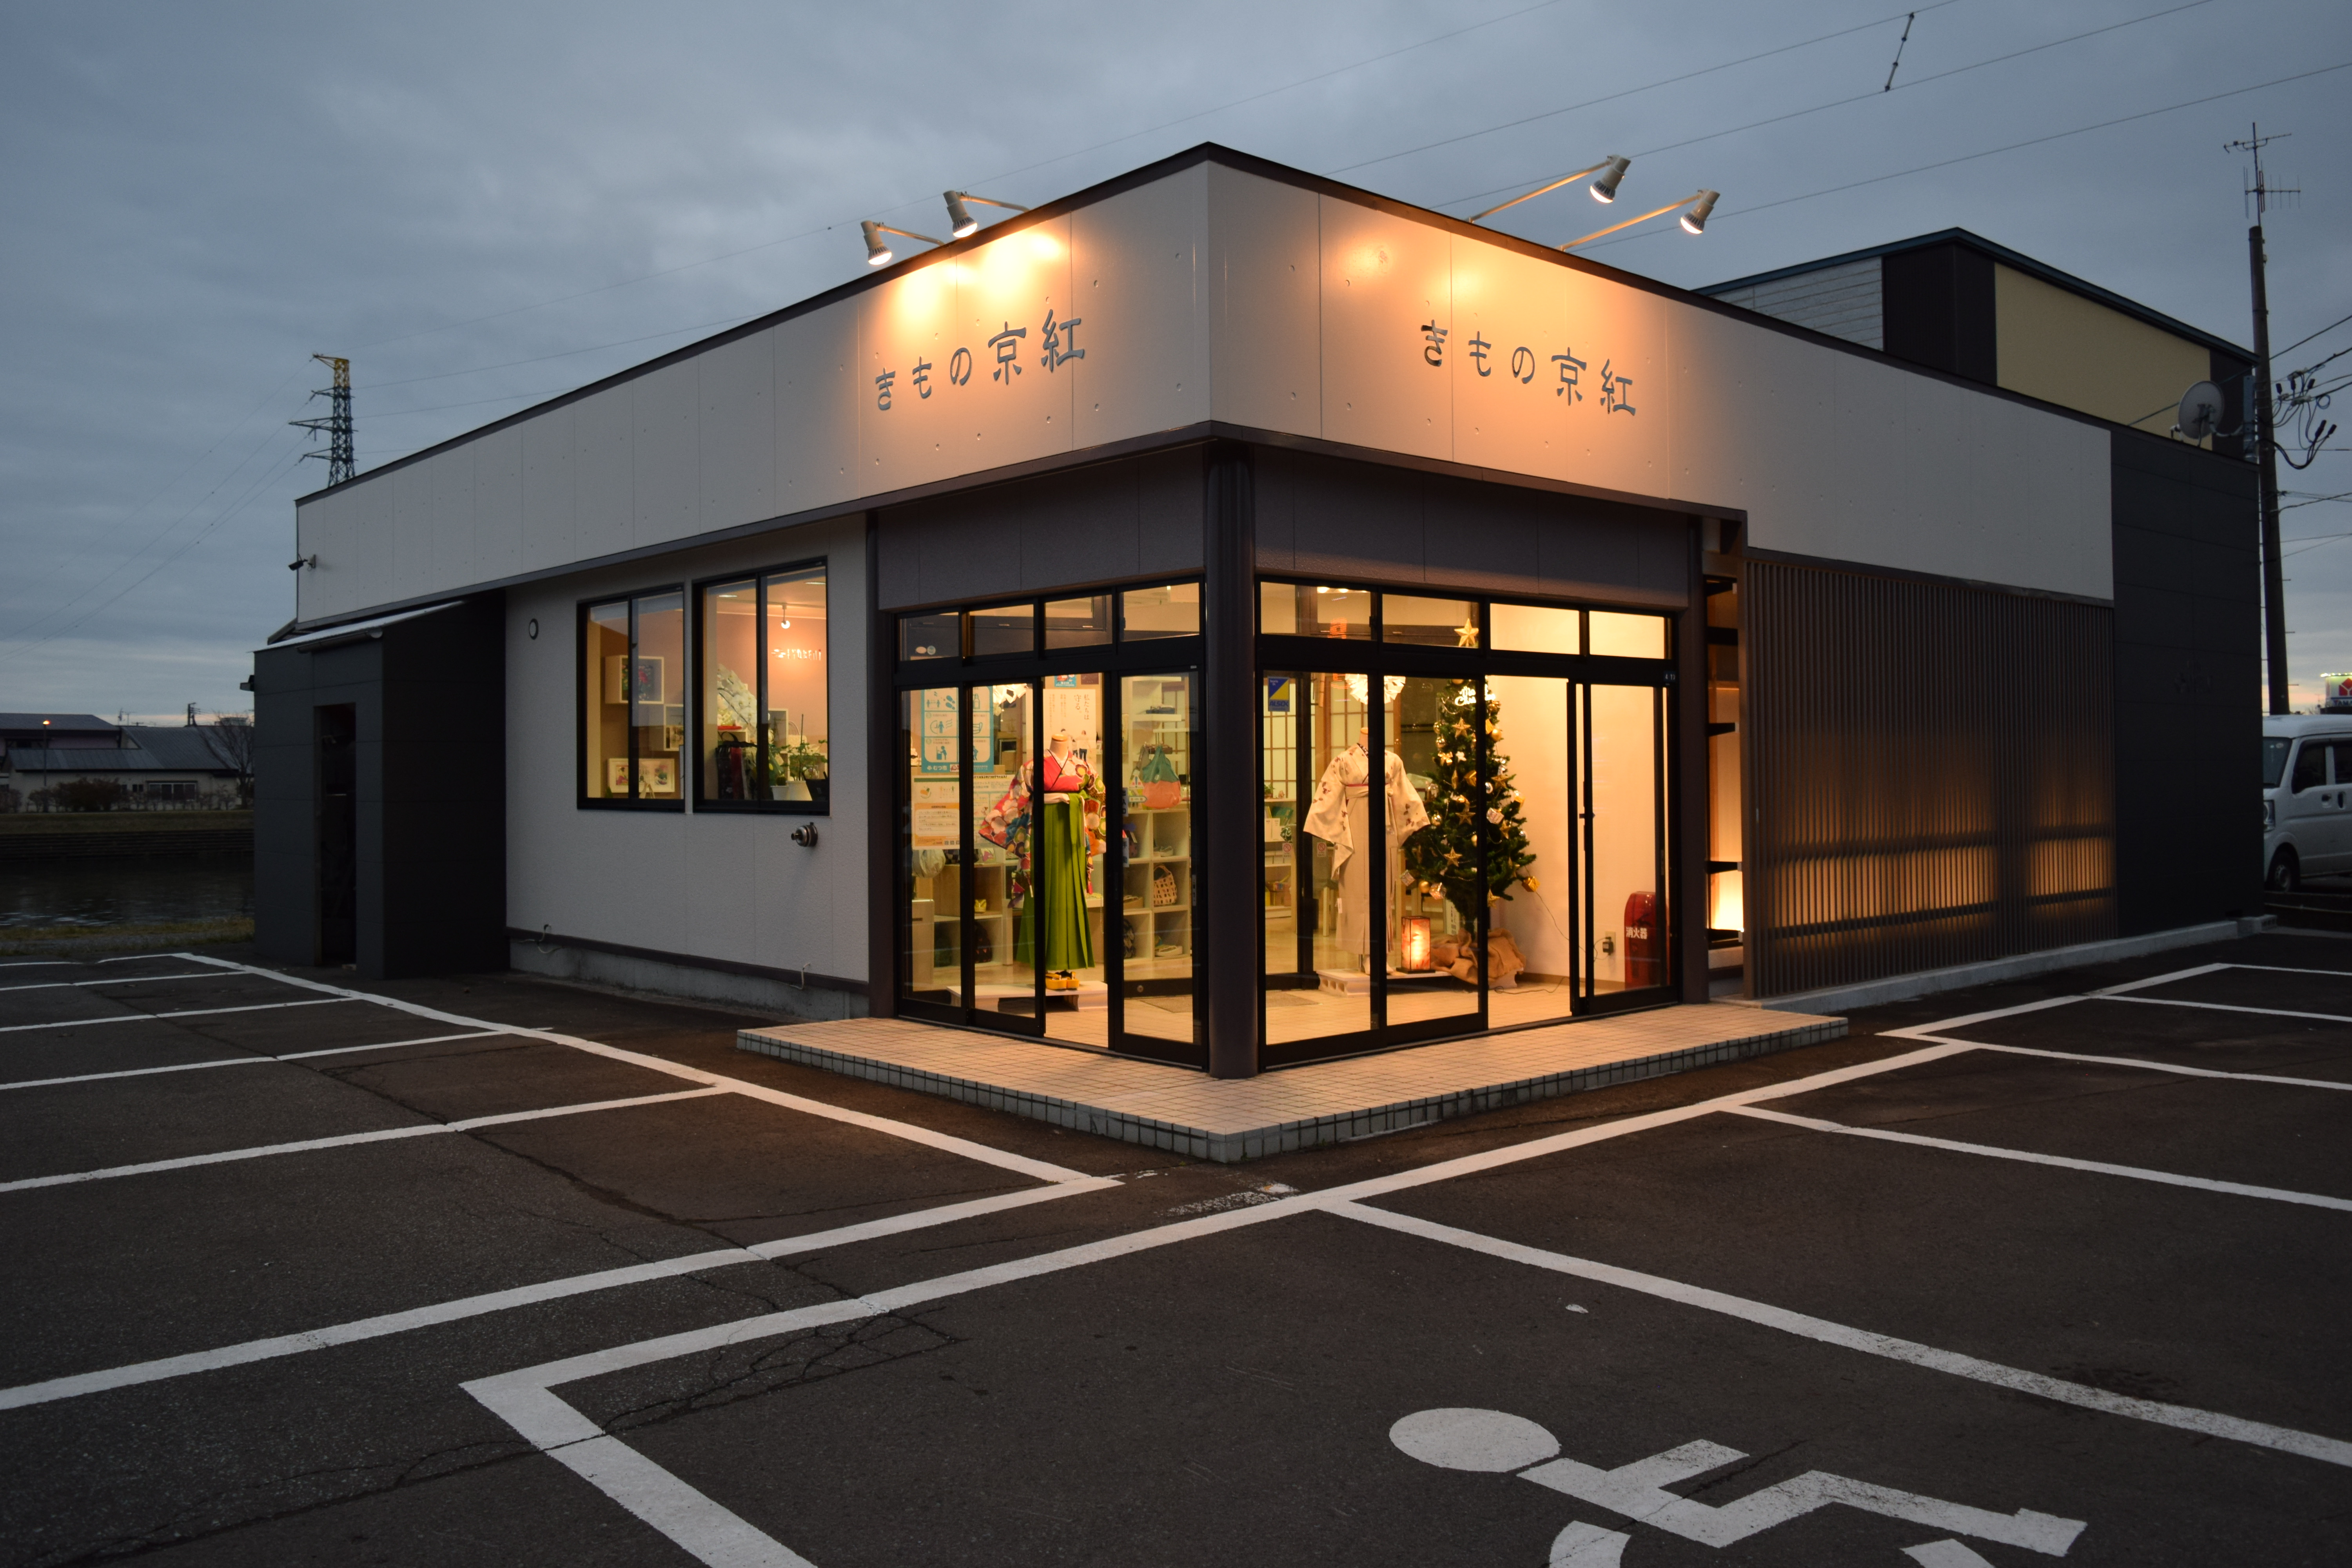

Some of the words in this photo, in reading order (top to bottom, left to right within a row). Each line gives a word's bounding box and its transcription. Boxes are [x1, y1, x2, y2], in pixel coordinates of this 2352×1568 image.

[875, 309, 1085, 410] きもの京紅
[1421, 319, 1636, 416] きもの京紅
[1626, 927, 1647, 939] 消火器
